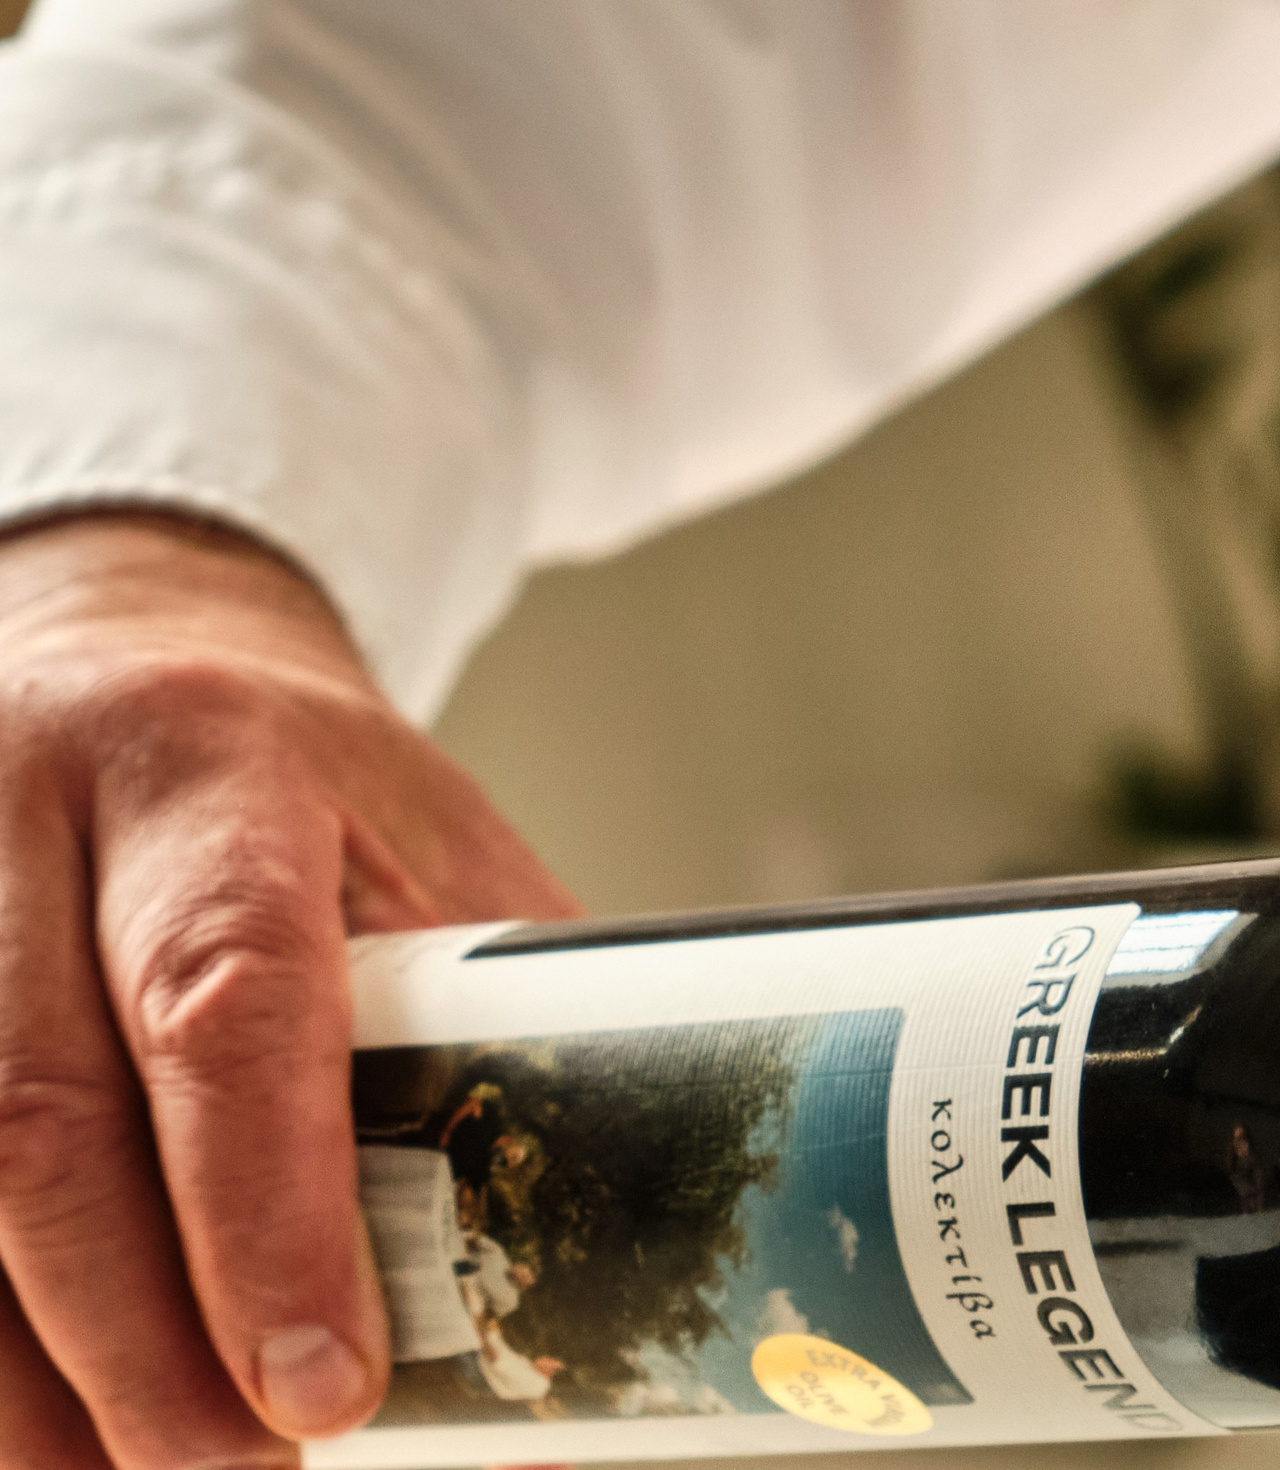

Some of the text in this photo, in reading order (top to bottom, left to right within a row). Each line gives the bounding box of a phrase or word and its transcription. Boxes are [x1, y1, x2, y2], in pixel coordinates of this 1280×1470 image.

[930, 1098, 996, 1340] κολεκτίβα
[1001, 925, 1184, 1432] GREEK LEGEND
[806, 1349, 881, 1390] EXTRA
